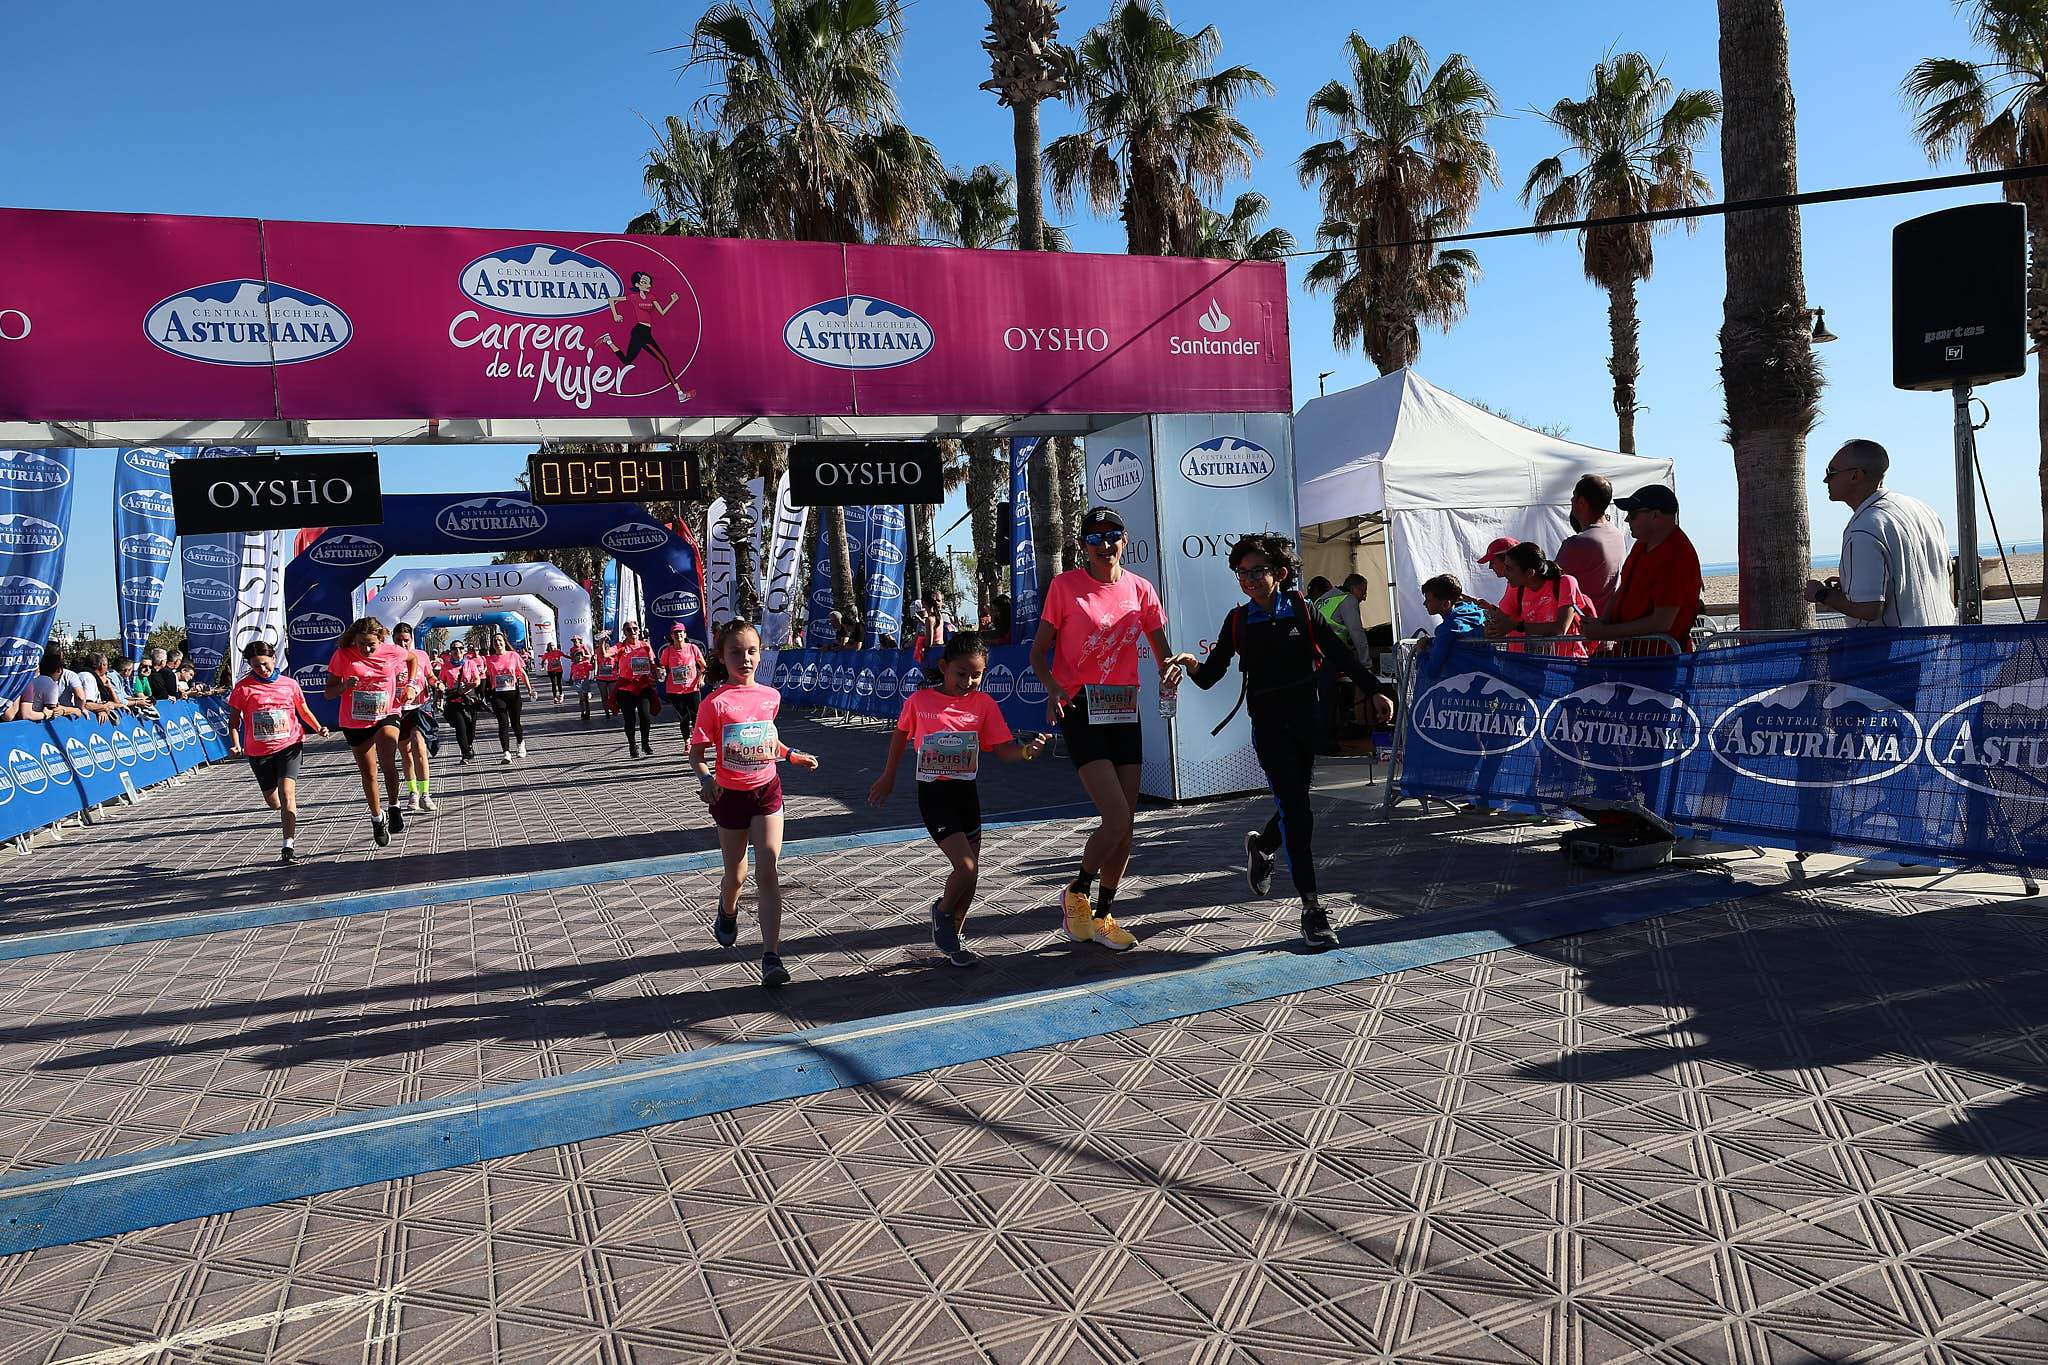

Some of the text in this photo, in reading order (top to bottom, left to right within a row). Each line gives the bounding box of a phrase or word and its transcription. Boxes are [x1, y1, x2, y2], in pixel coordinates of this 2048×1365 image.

[497, 267, 605, 279] CENTRAL LECHERA
[473, 268, 611, 300] ASTURIANA
[192, 308, 258, 318] CENTRAL
[162, 310, 339, 343] ASTURIANA
[448, 310, 586, 351] Carrera
[818, 320, 918, 329] CENTRAL LECHERA
[796, 321, 924, 350] ASTURIANA
[1003, 327, 1109, 351] OYSHO
[1169, 336, 1260, 355] Santander
[485, 347, 636, 410] de la Mujer
[129, 453, 170, 471] ASTURI
[1186, 456, 1268, 476] ASTURIANA
[0, 468, 62, 483] TURIANA
[541, 460, 690, 496] 00:58:41
[815, 461, 922, 486] OYSHO
[1097, 468, 1141, 493] ASTURIANA
[208, 478, 353, 508] OYSHO
[445, 511, 541, 531] ASTURIANA
[0, 532, 58, 546] TURIANA
[607, 533, 664, 548] ASTURIANA
[314, 548, 379, 559] ASTURIANA
[1120, 540, 1149, 566] SHO
[433, 570, 523, 591] OYSHO
[188, 621, 227, 631] STURIANA
[291, 625, 342, 636] ASTURIANA
[1441, 697, 1481, 708] CENTRAL
[1419, 698, 1528, 737] ASTURIANA
[1629, 711, 1684, 723] LECHERA
[1755, 715, 1899, 728] CENTRAL LECHERA
[1551, 708, 1690, 750] ASTURIANA
[1721, 716, 1902, 762] ASTURIANA
